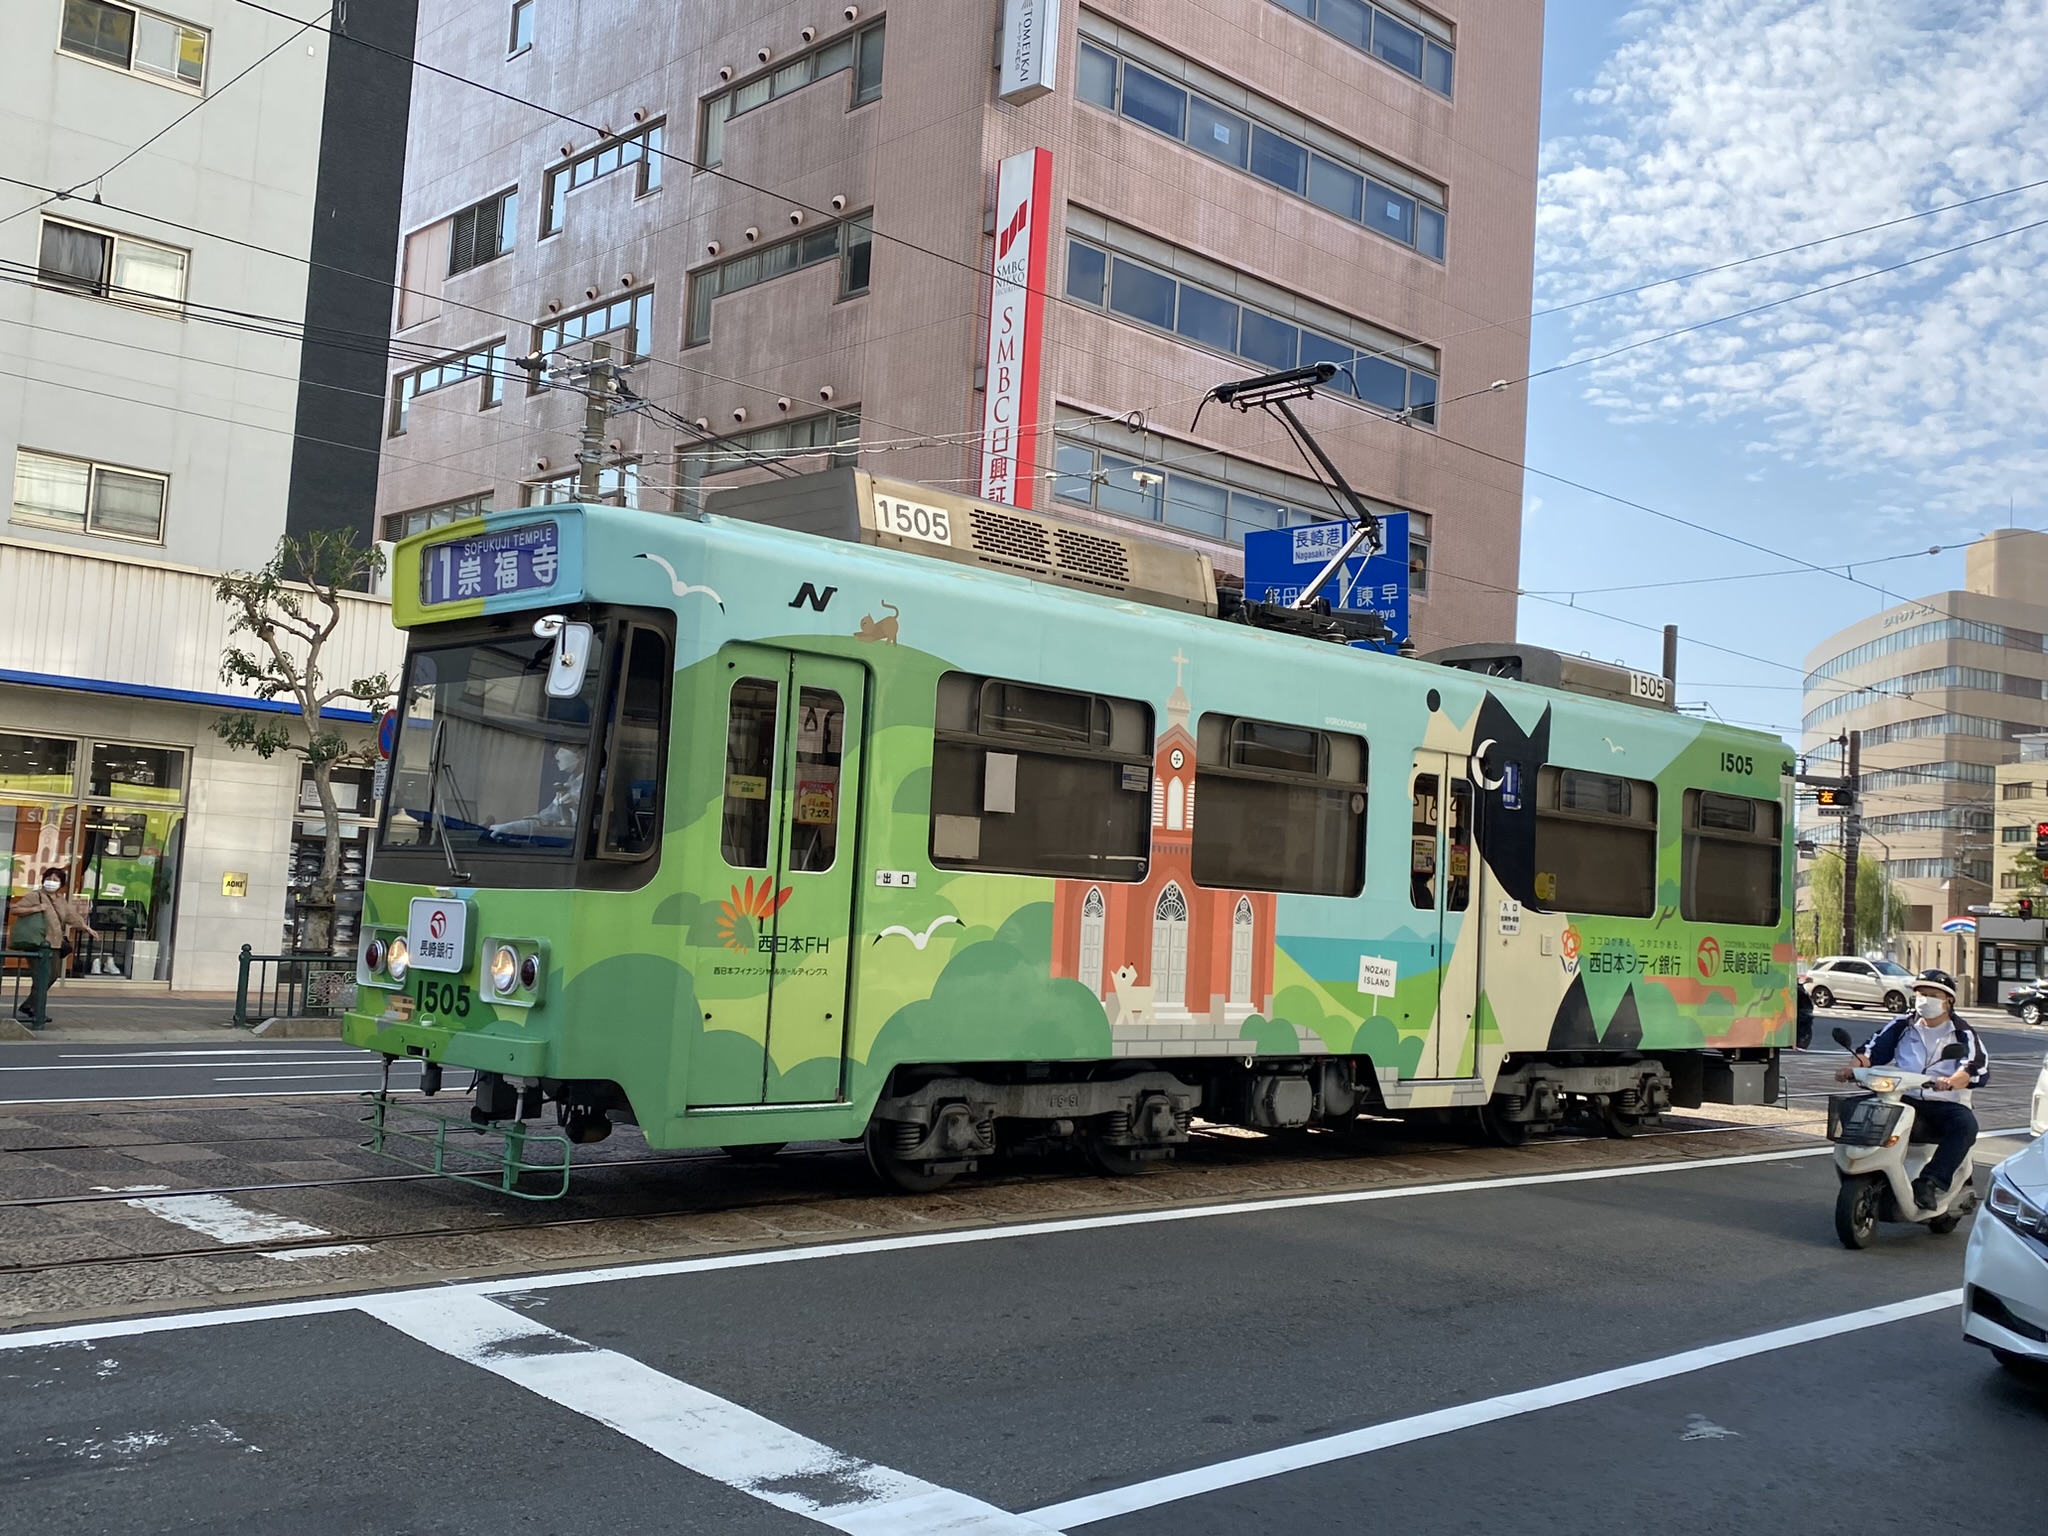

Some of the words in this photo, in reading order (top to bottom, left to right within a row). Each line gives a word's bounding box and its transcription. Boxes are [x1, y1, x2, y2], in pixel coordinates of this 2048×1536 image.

[1020, 8, 1033, 82] TOMEIKAI
[996, 258, 1026, 277] SMBC
[878, 499, 949, 541] 1505
[464, 536, 510, 556] SOFUKUJI
[513, 528, 552, 547] TEMPLE
[1295, 527, 1340, 549] 長崎港
[1295, 548, 1325, 561] Nagasaki
[440, 547, 451, 599] 1
[458, 543, 557, 595] 崇福寺
[1356, 583, 1399, 607] 諫早
[1633, 674, 1665, 699] 1505
[1721, 752, 1753, 775] 1505
[1821, 791, 1834, 803] 左
[27, 811, 74, 825] SUITS
[226, 880, 243, 888] AOKI
[883, 872, 909, 885] 出口
[1502, 902, 1518, 912] 入口
[419, 940, 454, 960] 長崎銀行
[758, 935, 829, 954] 西日本FH
[1364, 965, 1391, 977] NOZAKI
[1589, 952, 1681, 976] 西日本シティ銀行
[1722, 950, 1771, 975] 長崎銀行
[1363, 976, 1390, 988] ISLAND
[416, 980, 470, 1018] 1505
